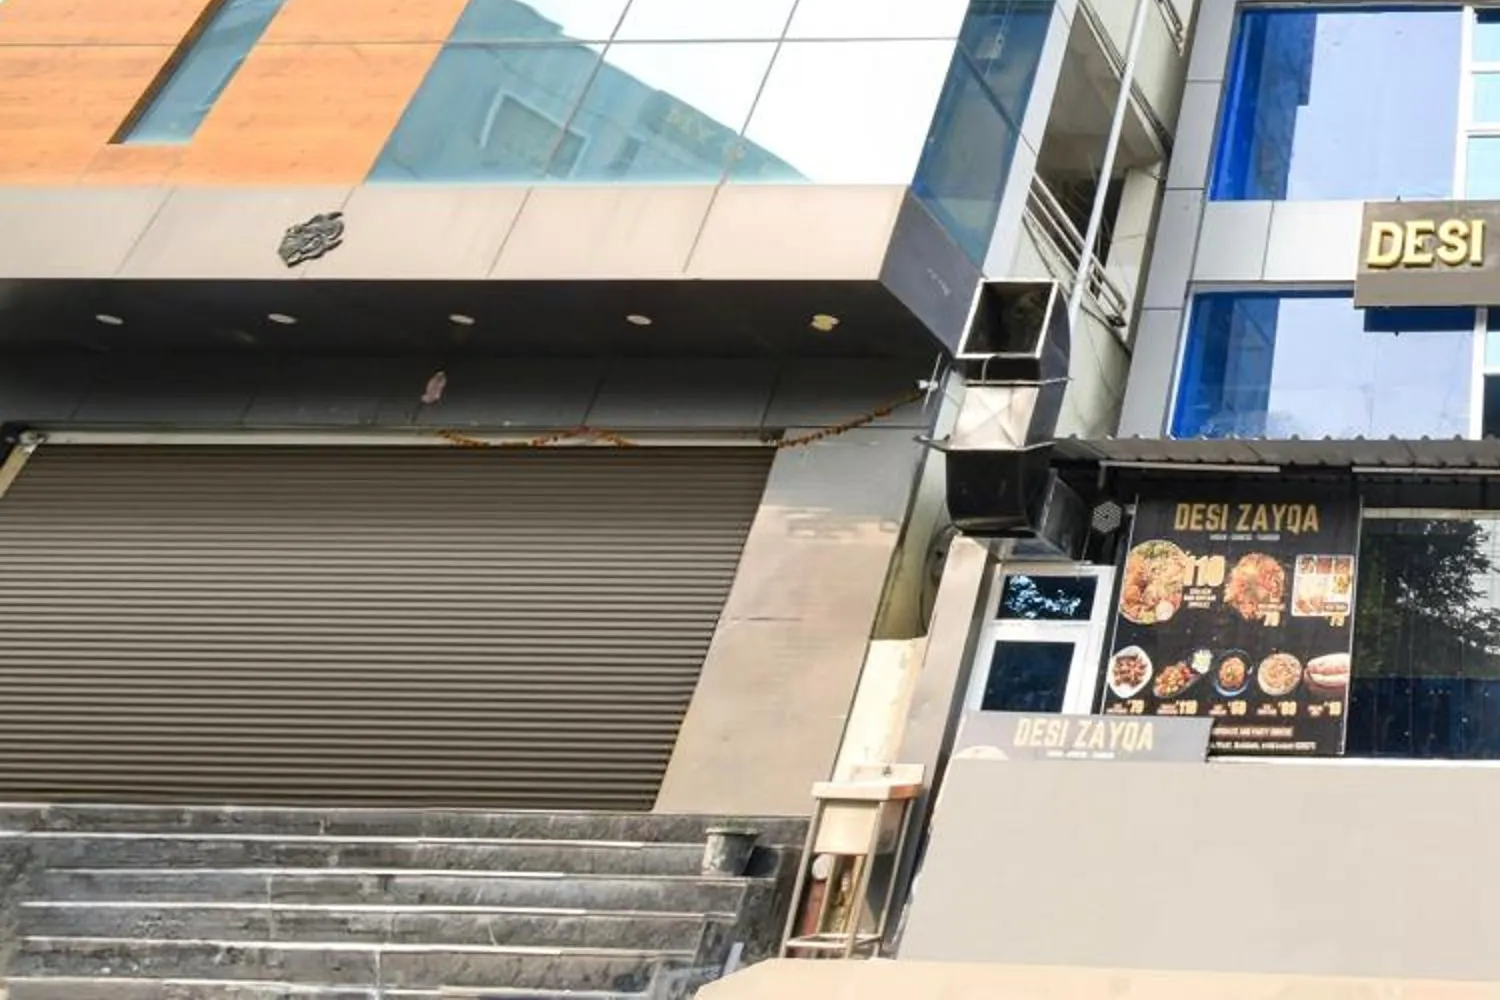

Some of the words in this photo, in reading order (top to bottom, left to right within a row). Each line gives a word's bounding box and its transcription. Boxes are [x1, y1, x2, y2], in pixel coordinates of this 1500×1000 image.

[1367, 218, 1485, 268] DESI
[1173, 503, 1229, 532] DESI
[1234, 503, 1320, 536] ZAYQA
[1013, 717, 1070, 748] DESI
[1073, 719, 1155, 752] ZAYQA
